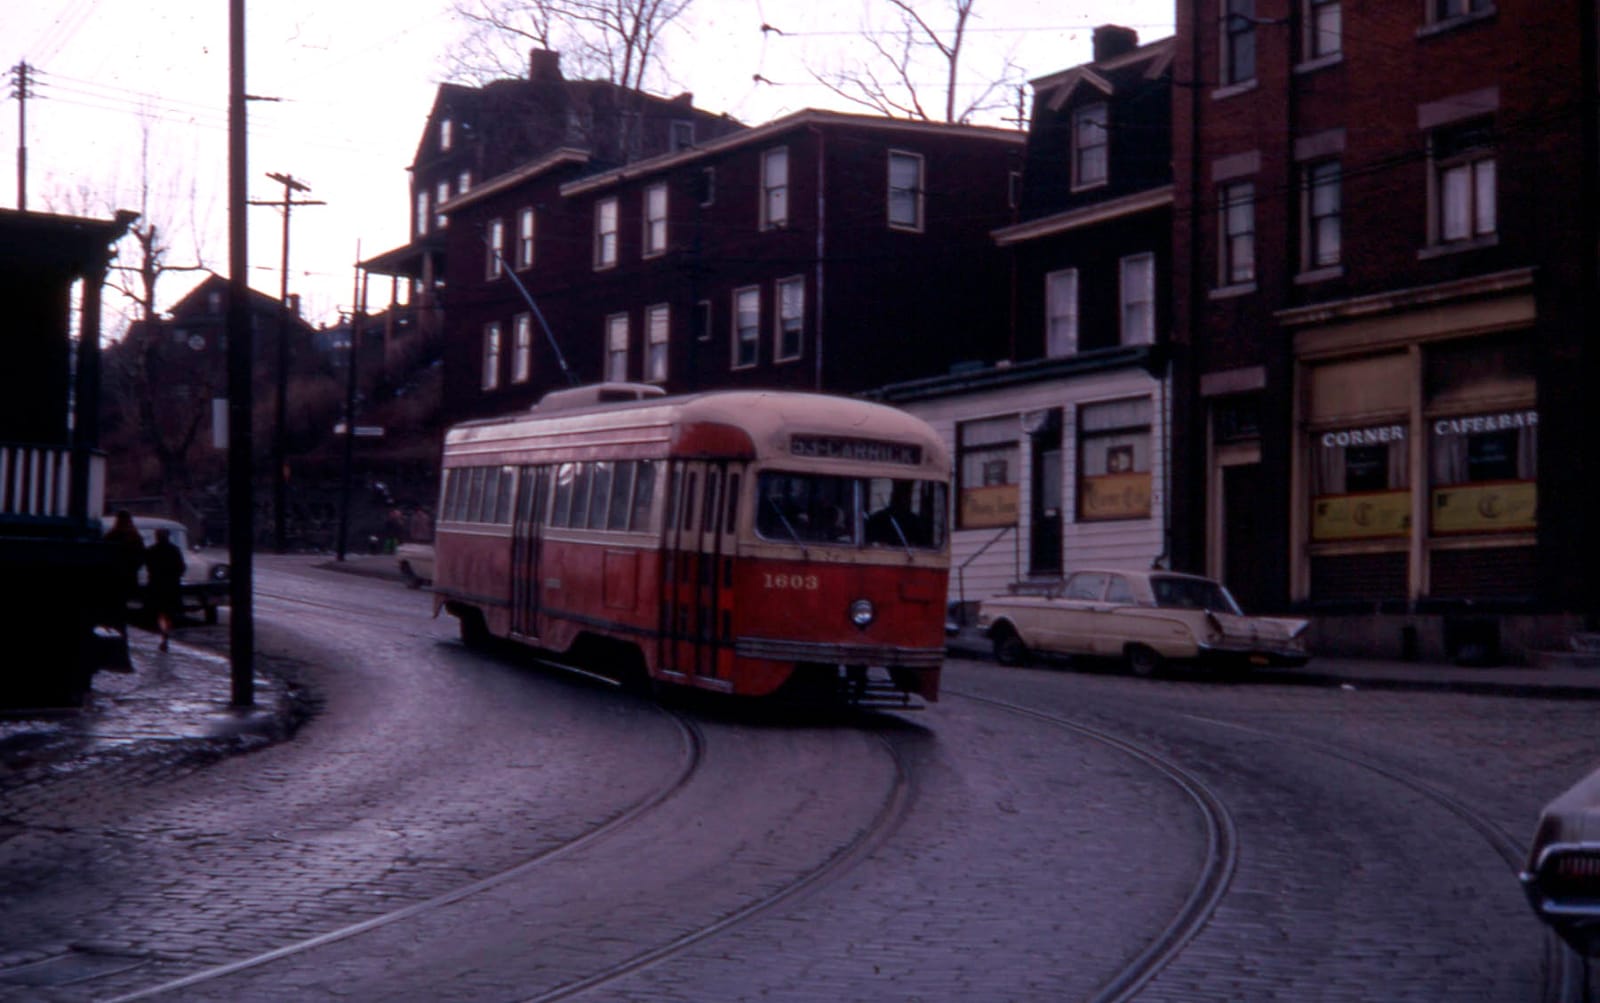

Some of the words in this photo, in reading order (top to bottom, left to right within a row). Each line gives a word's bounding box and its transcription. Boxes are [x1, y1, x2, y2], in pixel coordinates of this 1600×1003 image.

[1321, 425, 1404, 448] CORNER
[1434, 411, 1539, 435] CAFE&BAR
[762, 572, 819, 590] 1603
